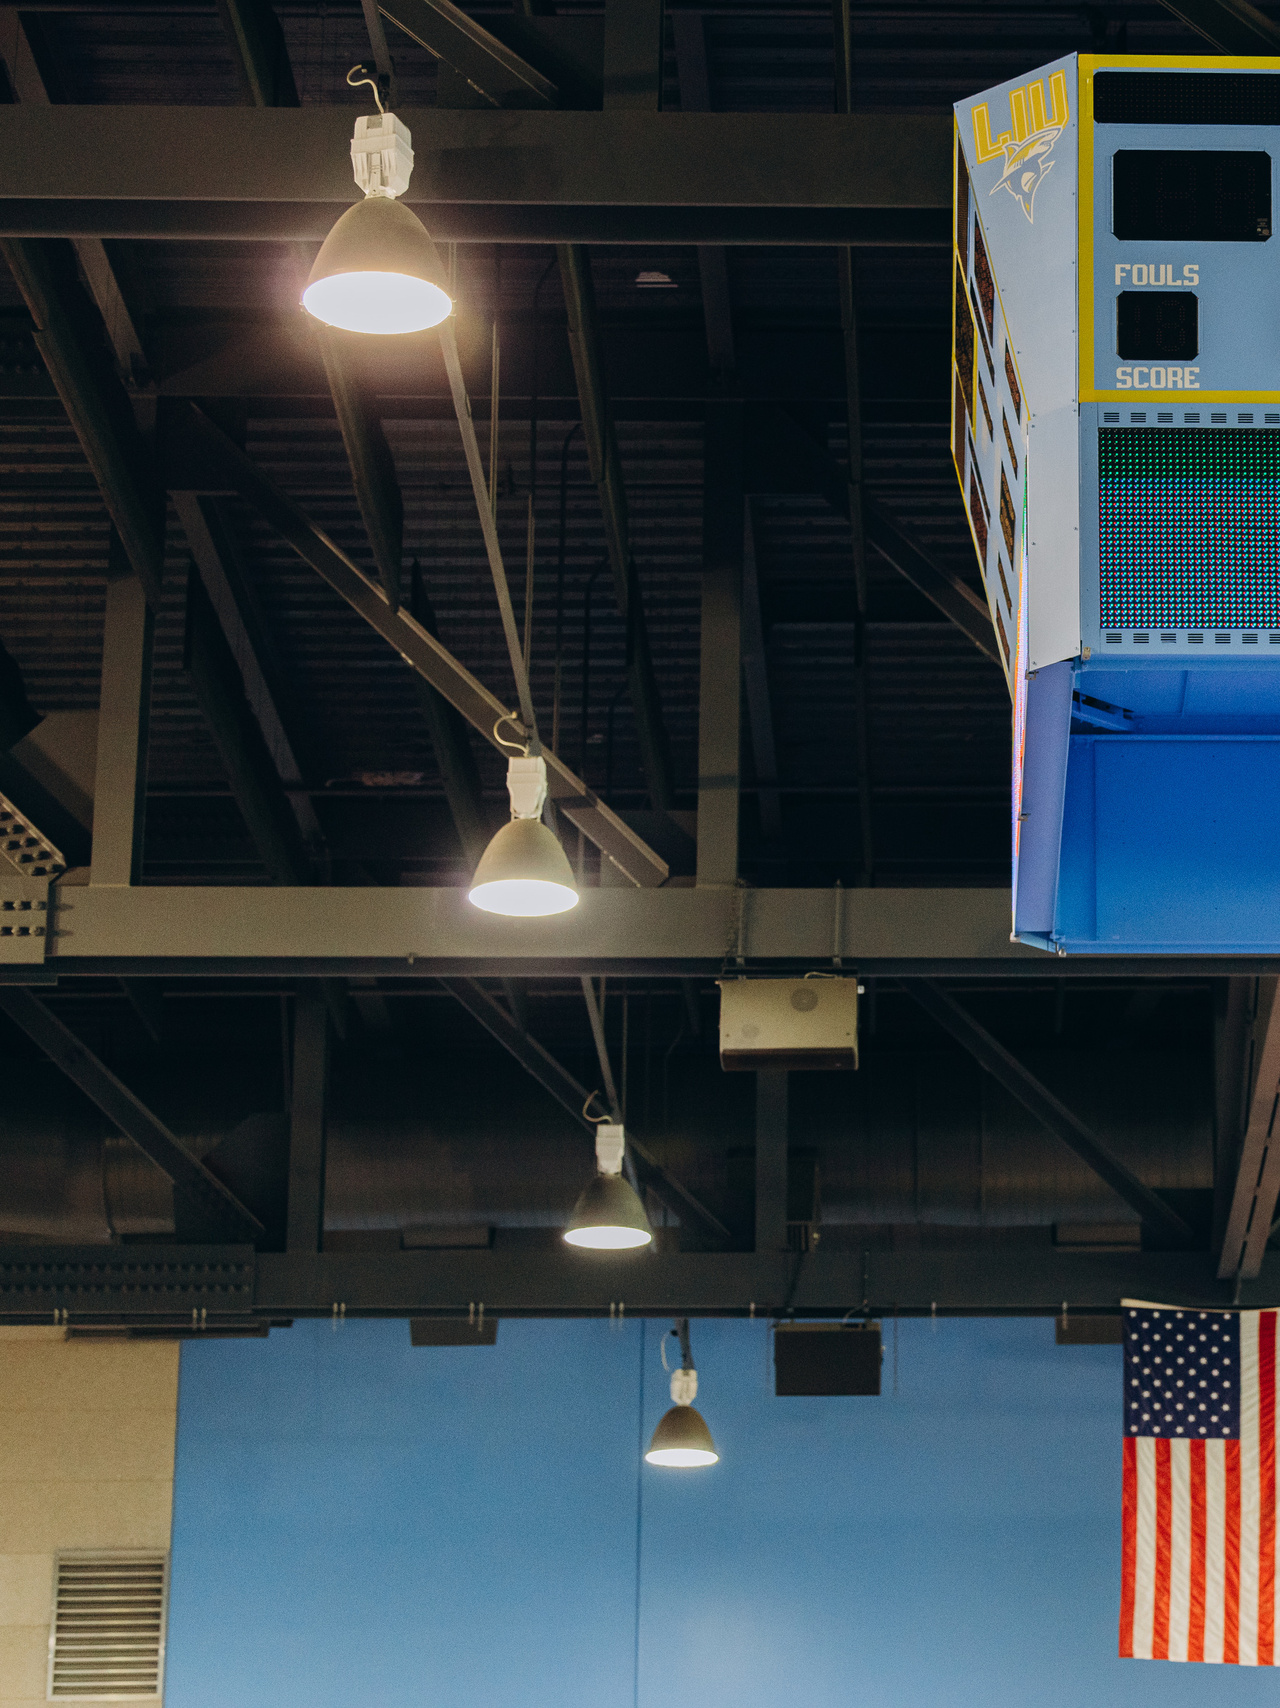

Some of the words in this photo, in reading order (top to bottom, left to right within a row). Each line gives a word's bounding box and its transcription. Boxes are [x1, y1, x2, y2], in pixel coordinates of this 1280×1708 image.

[971, 69, 1070, 165] LIU
[1114, 263, 1199, 287] FOULS
[1115, 366, 1200, 390] SCORE
